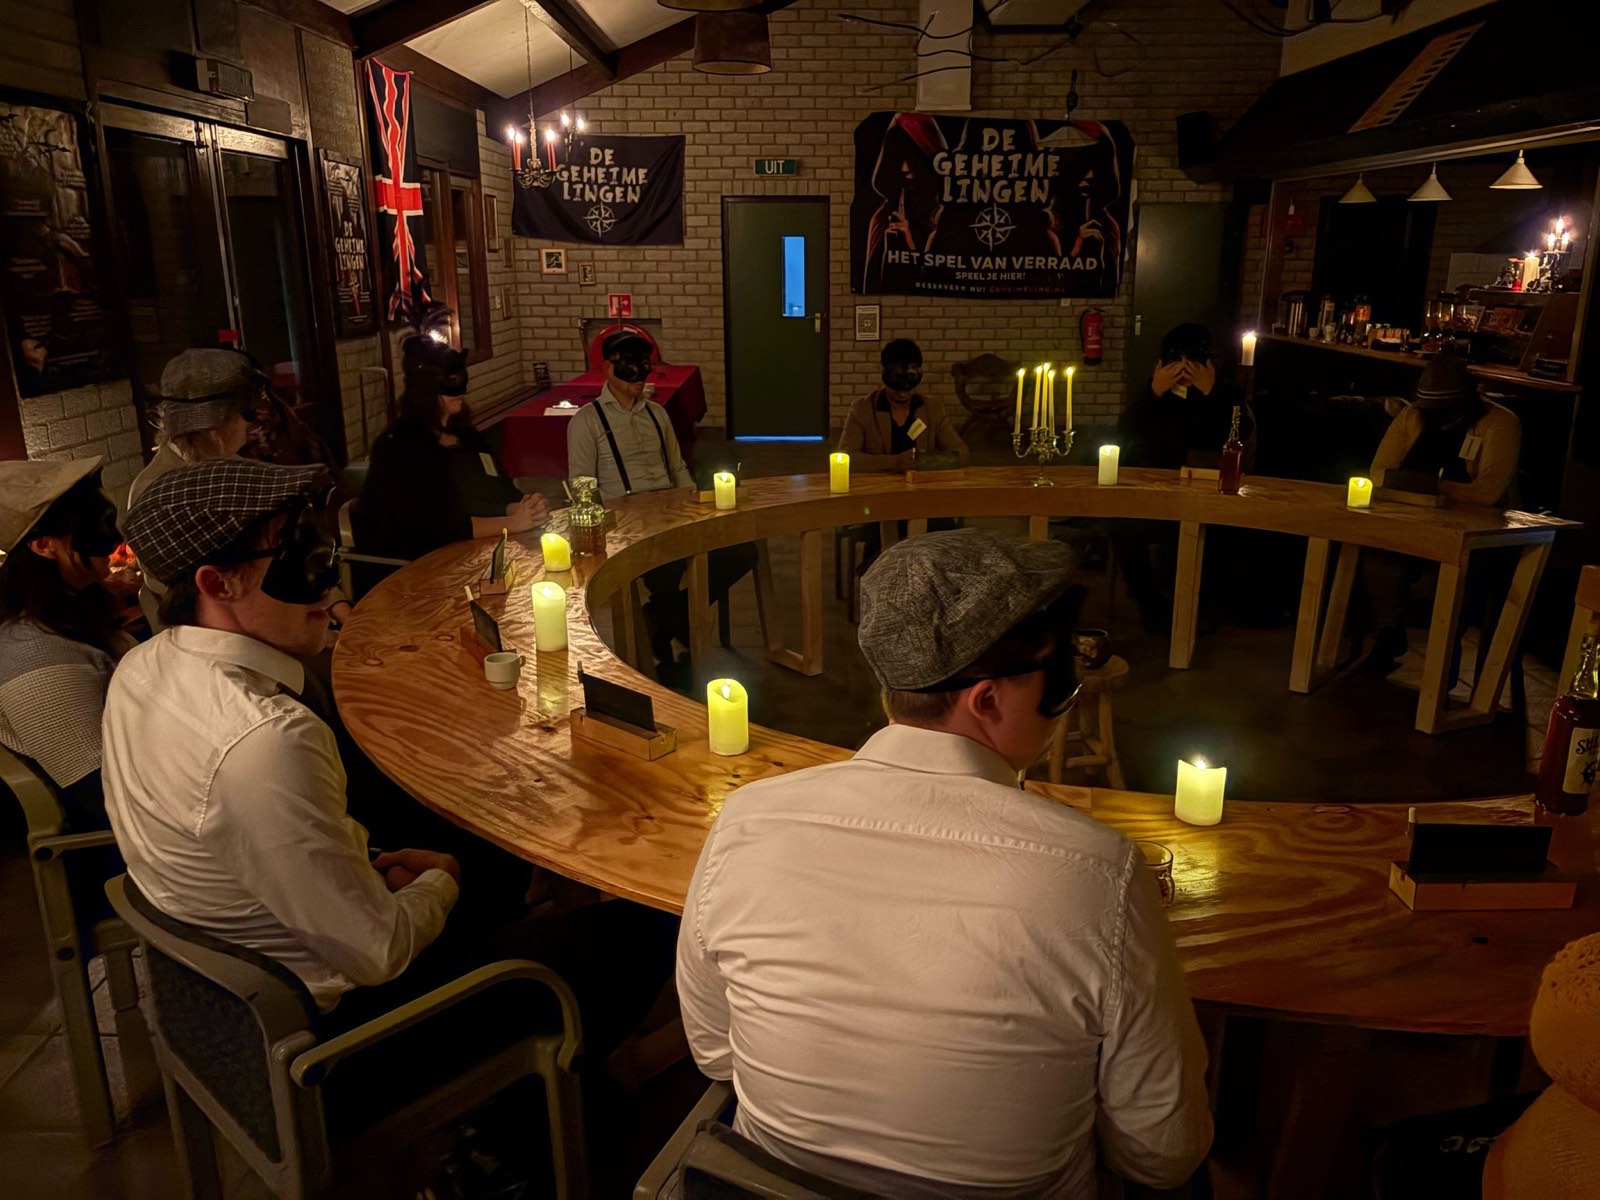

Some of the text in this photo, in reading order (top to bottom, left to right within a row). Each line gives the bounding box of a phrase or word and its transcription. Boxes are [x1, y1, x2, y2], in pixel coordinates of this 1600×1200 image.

[982, 127, 1016, 152] DE
[589, 146, 615, 166] DE
[932, 151, 1061, 178] GEHEIME
[556, 164, 649, 185] GEHEIME
[764, 160, 785, 174] UIT
[563, 181, 641, 204] LINGEN
[942, 176, 1050, 203] LINGEN
[343, 220, 353, 237] DE
[887, 249, 1098, 270] HET SPEL VAN VERRAAD
[955, 271, 1026, 281] SPEEL JE HIER!
